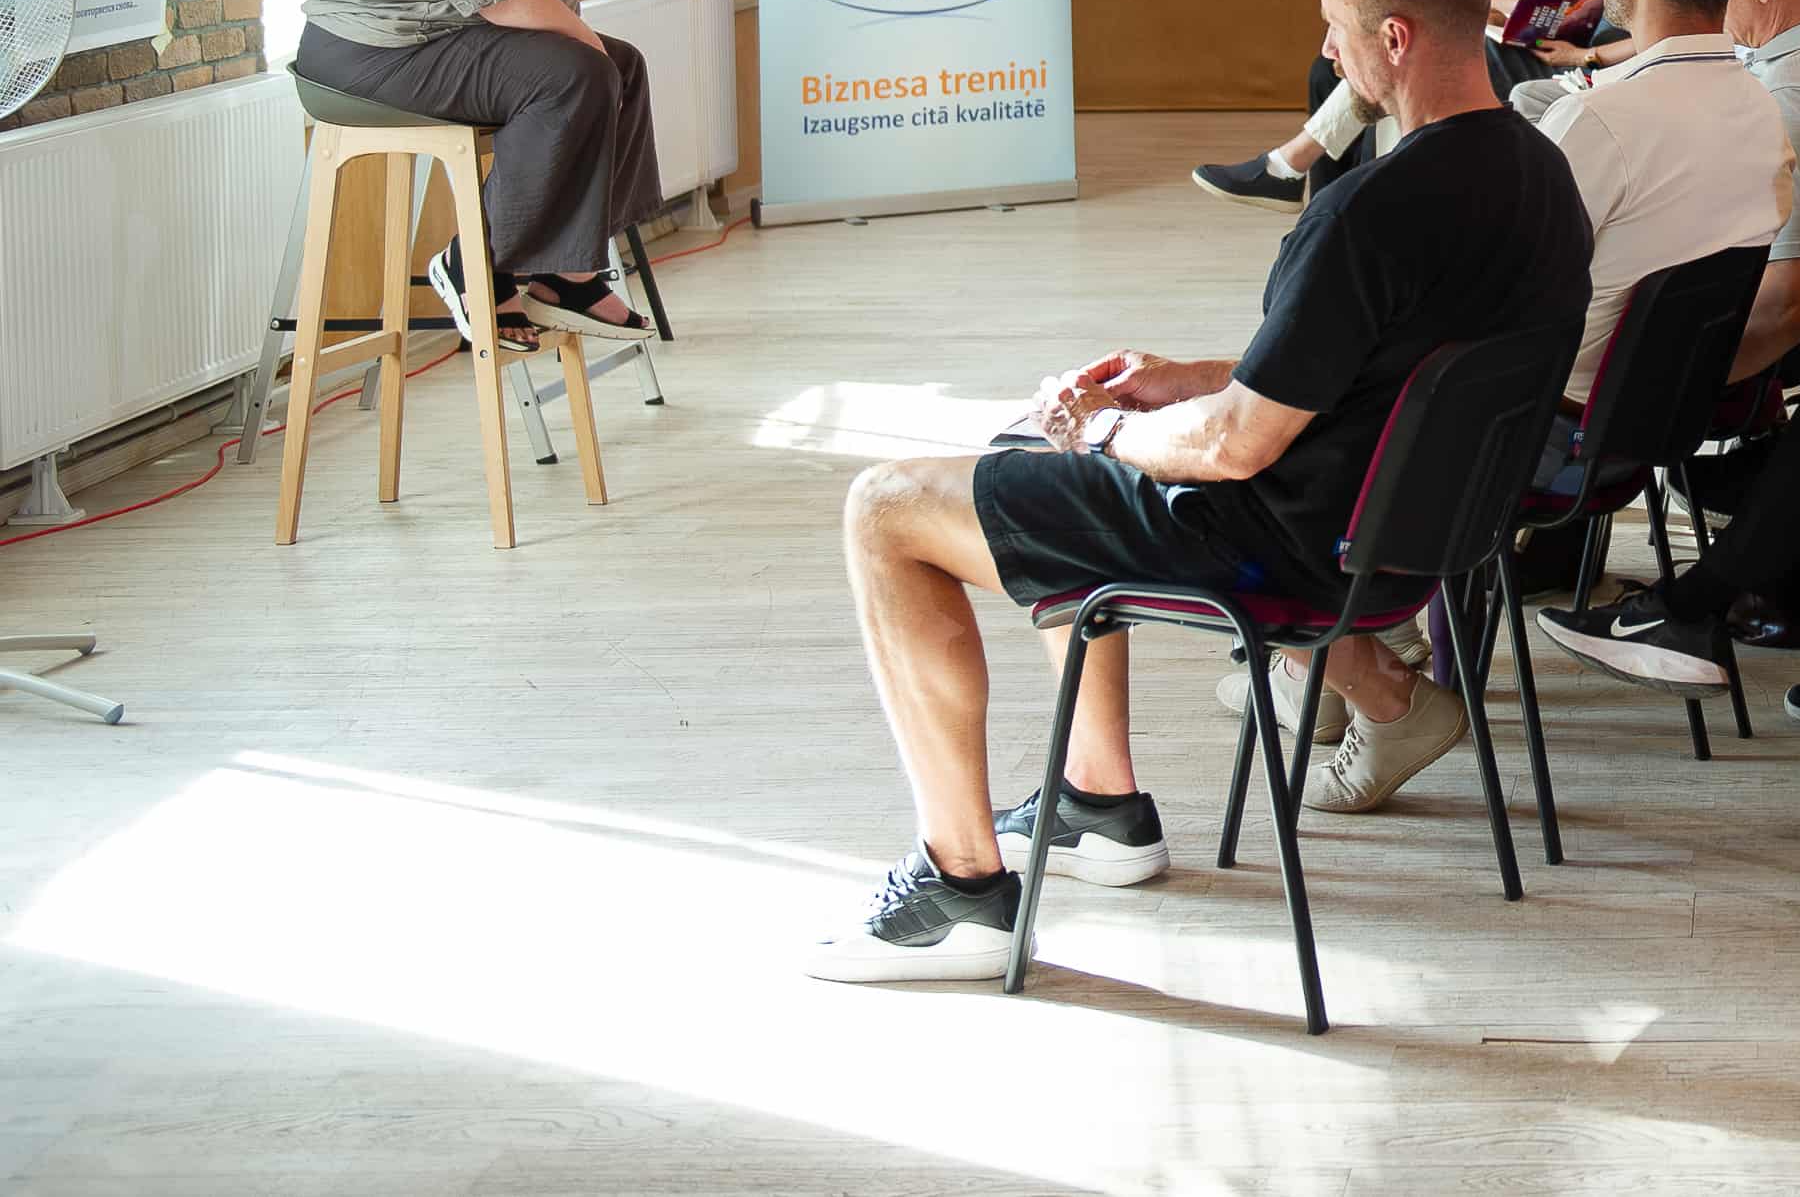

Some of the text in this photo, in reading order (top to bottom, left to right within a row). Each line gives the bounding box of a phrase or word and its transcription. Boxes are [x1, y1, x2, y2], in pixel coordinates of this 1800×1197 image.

[801, 60, 1048, 105] Biznesa treniņi
[804, 98, 1046, 136] Izaugsme citā kvalitātē
